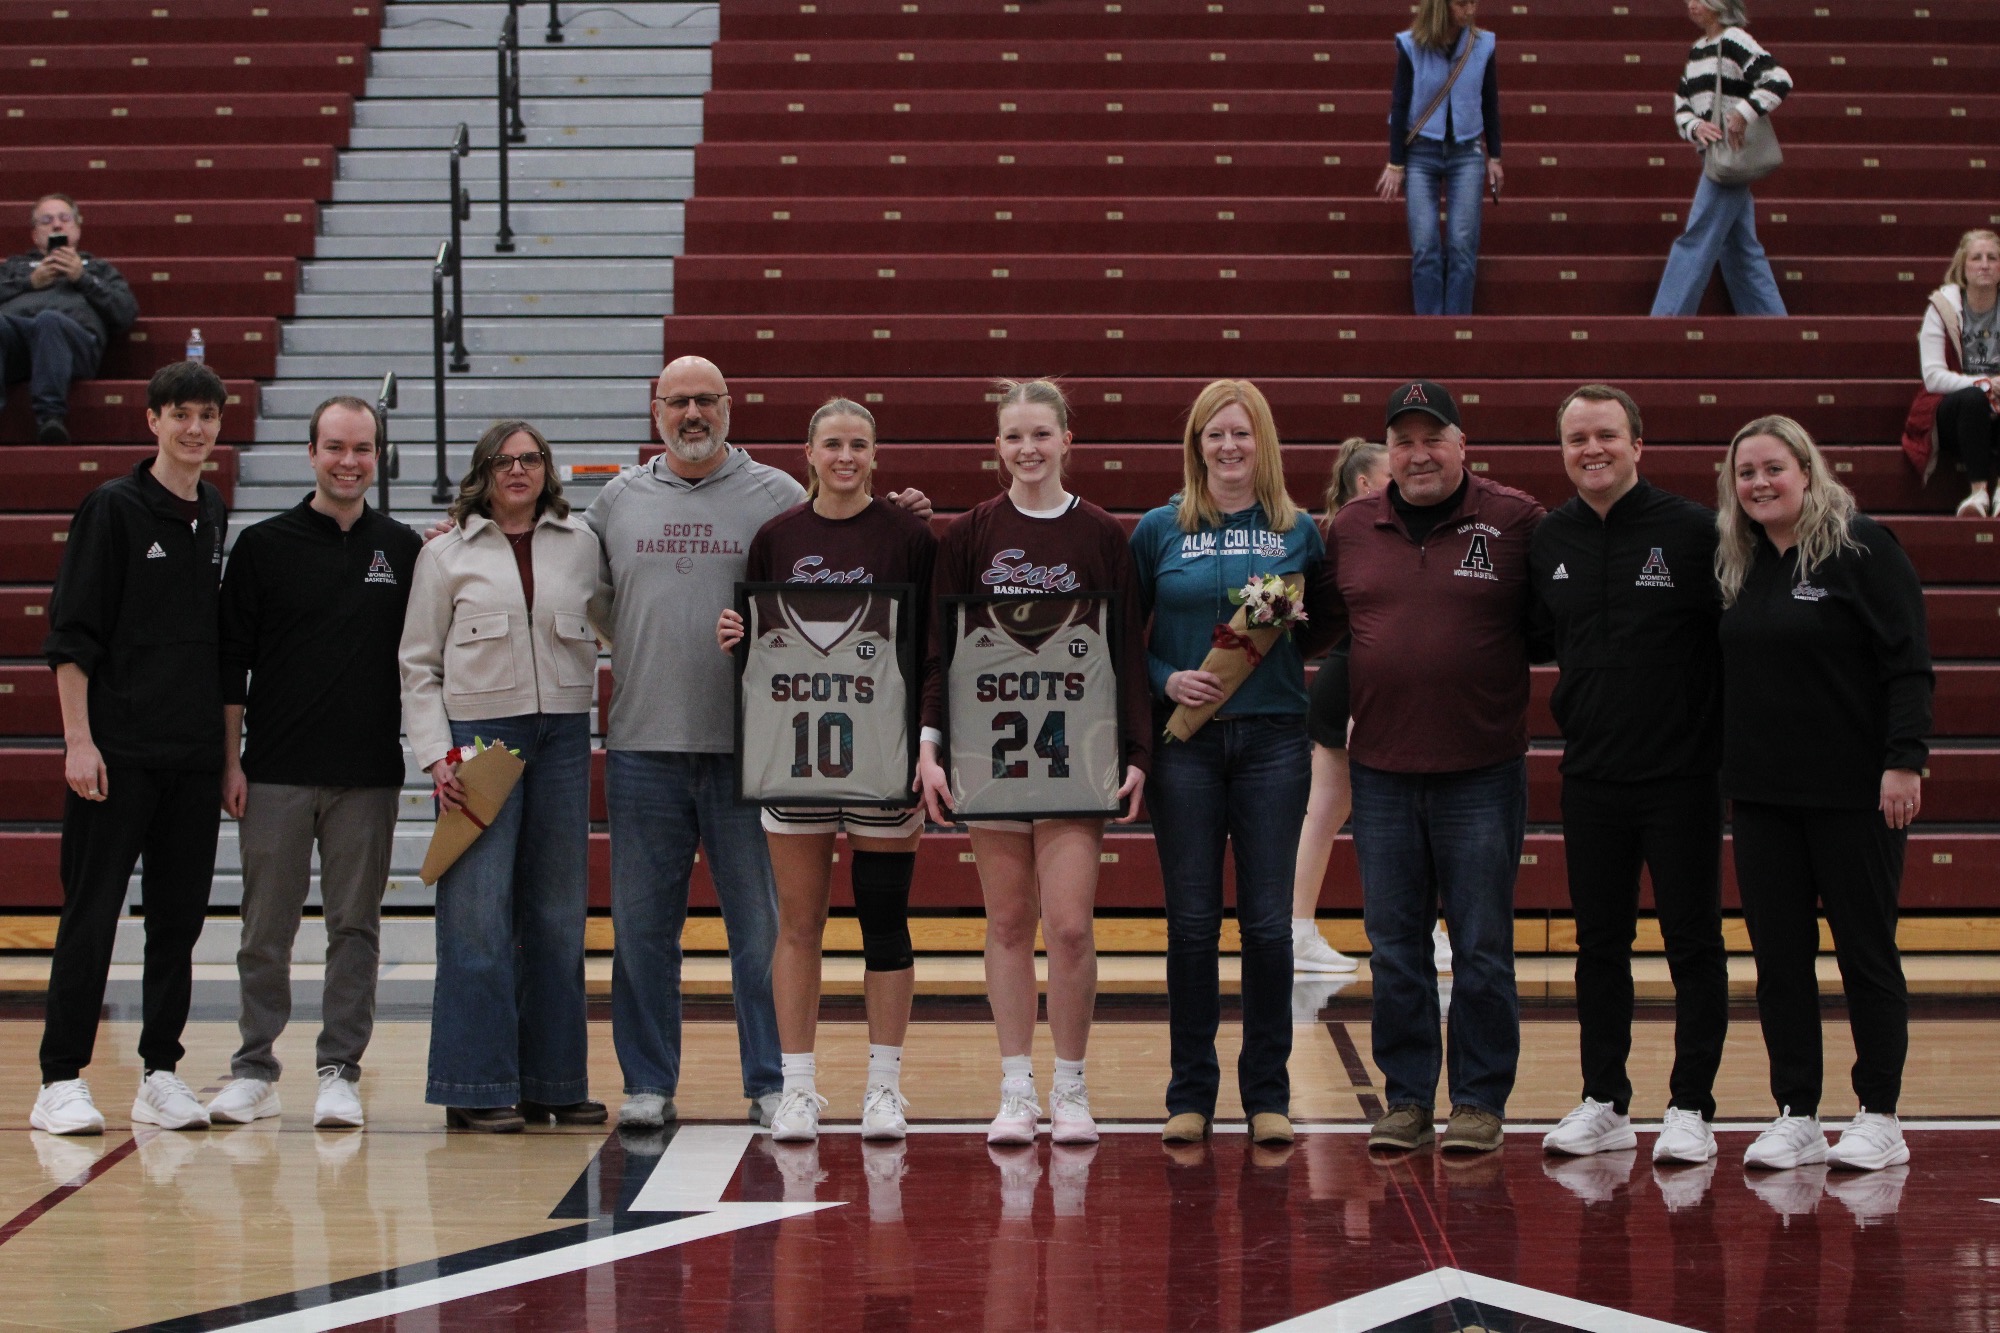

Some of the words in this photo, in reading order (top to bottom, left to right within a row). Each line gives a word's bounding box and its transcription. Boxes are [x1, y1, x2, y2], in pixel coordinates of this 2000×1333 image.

[1403, 383, 1428, 404] A
[663, 524, 713, 537] SCOTS
[1224, 529, 1287, 550] COLLEGE
[1457, 524, 1474, 534] ALMA
[1475, 523, 1502, 538] COLLEGE
[146, 551, 167, 559] adidas
[636, 539, 743, 554] BASKETBALL
[1461, 534, 1493, 572] A
[370, 550, 392, 572] A
[981, 549, 1081, 592] Scots
[1642, 547, 1669, 574] A
[364, 577, 398, 585] BASKETBALL
[1635, 580, 1675, 588] BASKETBALL
[1639, 574, 1671, 582] WOMEN'S
[857, 645, 876, 656] TE
[1069, 642, 1087, 654] TE
[771, 672, 875, 704] SCOTS
[976, 671, 1085, 703] SCOTS
[791, 711, 854, 778] 10
[991, 710, 1070, 779] 24
